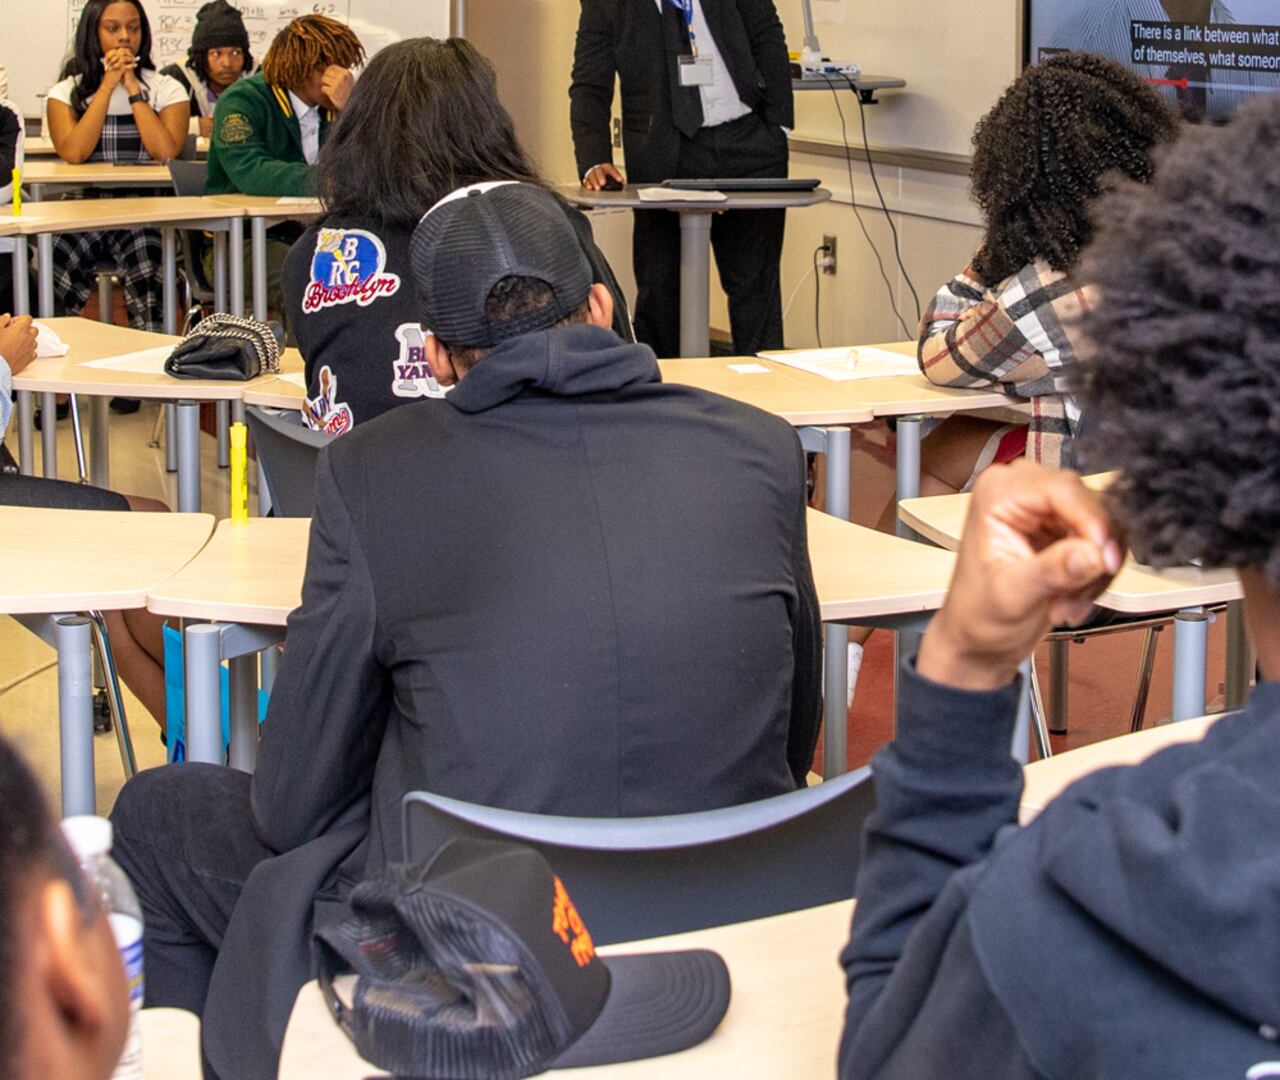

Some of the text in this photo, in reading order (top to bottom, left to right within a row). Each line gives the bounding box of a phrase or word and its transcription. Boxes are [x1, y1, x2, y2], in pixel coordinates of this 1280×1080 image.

[1133, 24, 1160, 40] There
[1163, 26, 1172, 40] is
[1175, 29, 1181, 40] a
[1184, 26, 1201, 41] link
[1204, 27, 1249, 44] between
[1252, 30, 1279, 46] what
[1134, 45, 1145, 61] of
[1147, 48, 1207, 67] themselves,
[1210, 50, 1235, 66] what
[305, 274, 396, 312] Brooklyn
